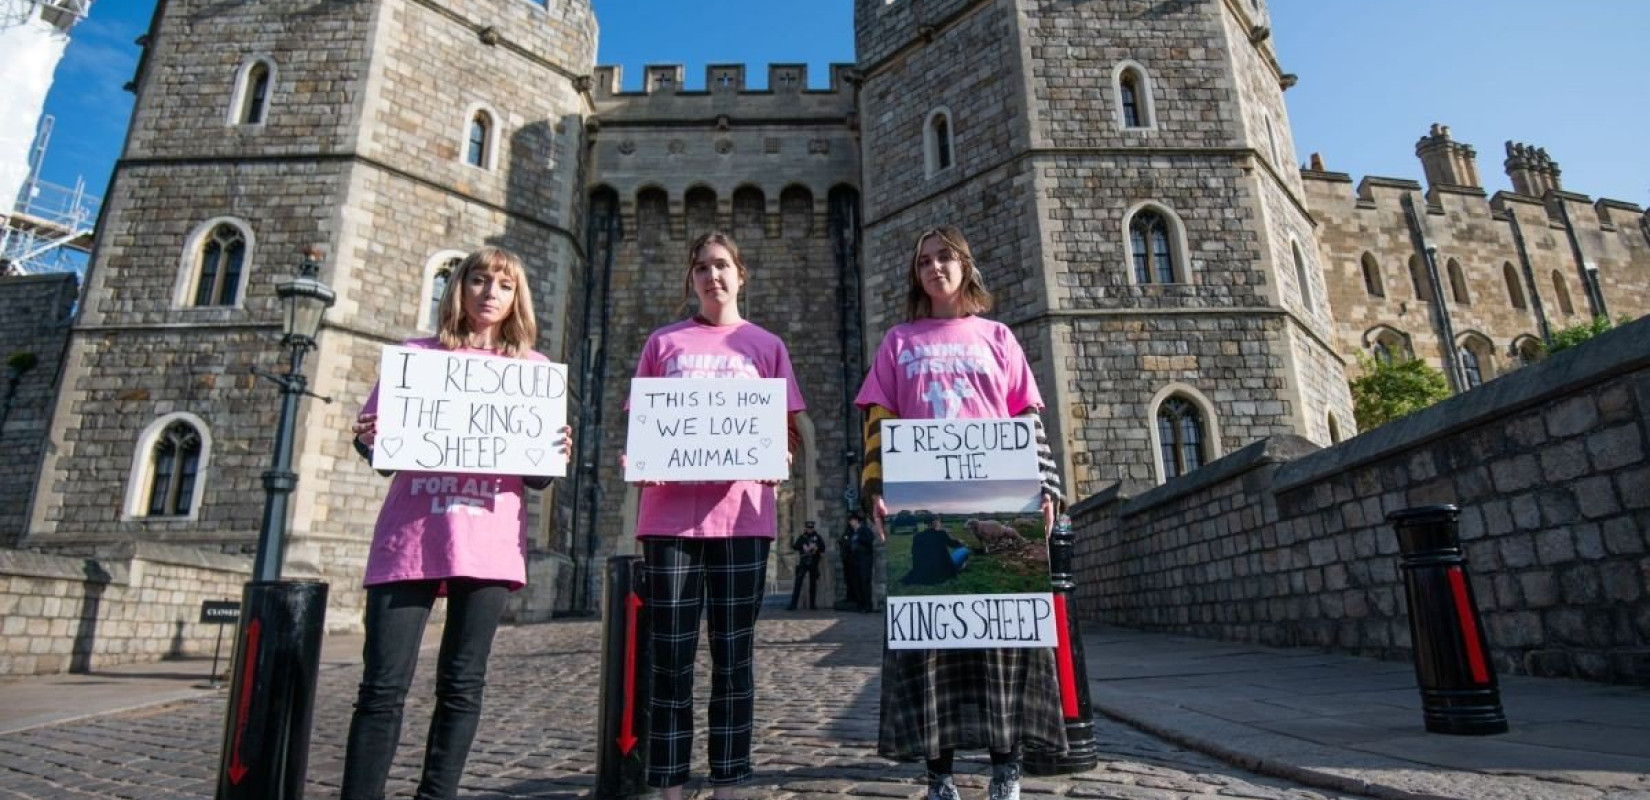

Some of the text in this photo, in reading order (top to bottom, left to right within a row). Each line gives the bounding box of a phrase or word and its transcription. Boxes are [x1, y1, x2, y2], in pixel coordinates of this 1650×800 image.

[395, 352, 566, 399] I RESCUED
[645, 391, 771, 409] THIS IS HOW
[395, 395, 544, 438] THE KING'S
[656, 416, 760, 438] WE LOVE
[415, 432, 508, 470] SHEEP
[885, 421, 1031, 453] I RESCUED
[667, 447, 760, 469] ANIMALS
[935, 451, 989, 481] THE
[410, 476, 459, 496] FOR
[430, 495, 486, 516] LIFE
[889, 597, 1051, 642] KING'S SHEEP
